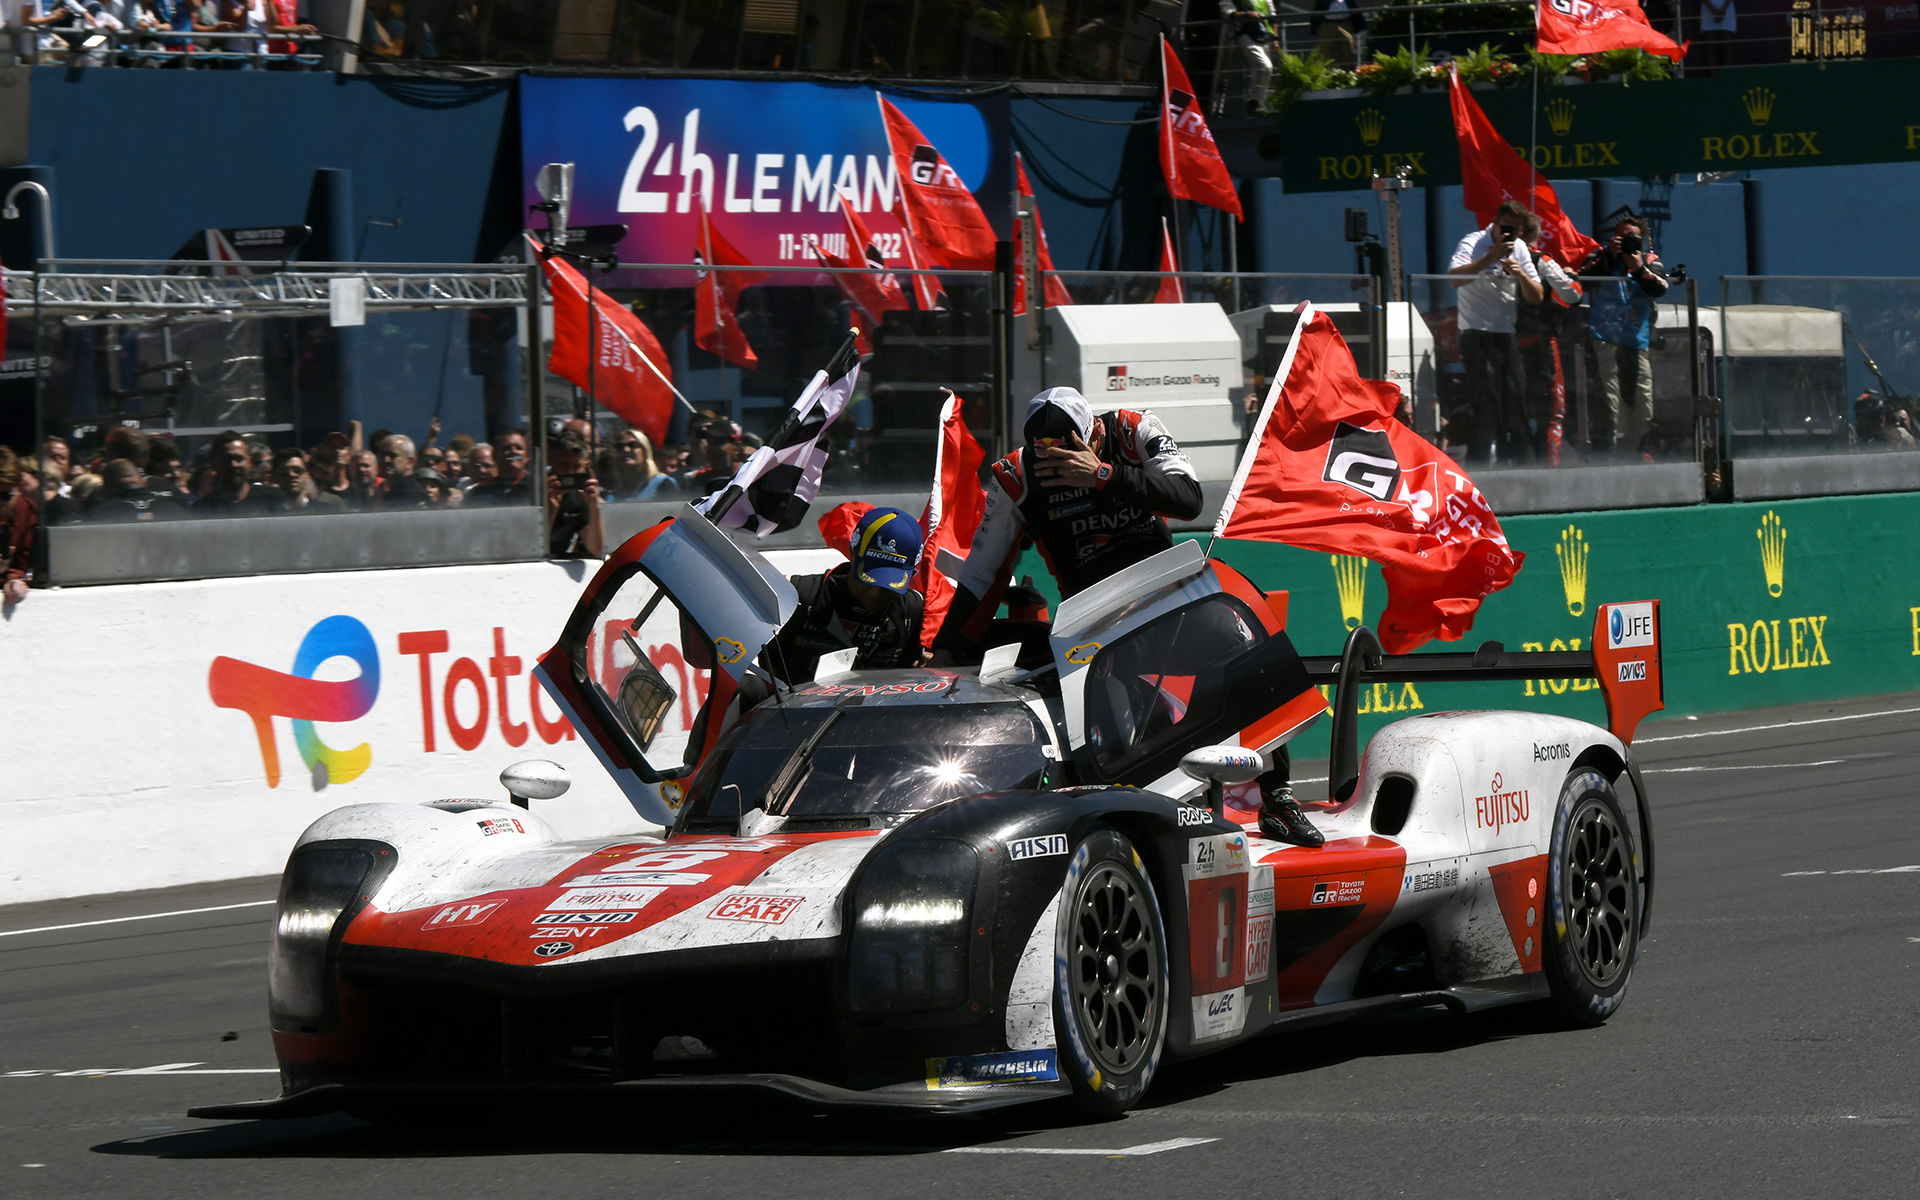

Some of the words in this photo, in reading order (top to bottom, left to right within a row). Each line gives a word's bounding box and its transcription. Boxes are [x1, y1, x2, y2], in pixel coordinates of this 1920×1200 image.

[1701, 131, 1822, 161] ROLEX
[616, 106, 715, 213] 24h
[724, 153, 785, 213] LE
[791, 153, 899, 213] MAN
[1319, 152, 1428, 180] ROLEX
[1129, 376, 1161, 387] TOYOTA
[1163, 375, 1192, 386] GAZOO
[1193, 374, 1220, 388] Racing
[1390, 369, 1413, 382] Racin
[865, 550, 907, 564] MICHELIN
[1625, 616, 1651, 637] JFE
[1726, 615, 1832, 676] ROLEX
[796, 681, 950, 697] DENSO
[1225, 756, 1250, 768] Mobil
[1533, 742, 1571, 763] Acronis
[1177, 807, 1213, 827] RAYS
[1475, 789, 1530, 838] FUJITSU
[1012, 836, 1067, 858] AISIN
[1196, 840, 1215, 864] 24h
[601, 851, 730, 873] 8
[1339, 887, 1363, 896] GAZOO
[1341, 880, 1365, 889] TOYOTA
[726, 896, 796, 907] HYPER
[1312, 891, 1337, 904] GR
[1337, 894, 1361, 903] Racing
[429, 903, 498, 925] HY
[533, 912, 634, 923] AISIN
[716, 903, 788, 921] CAR
[529, 926, 609, 939] ZENT
[1215, 886, 1237, 979] 8
[1247, 921, 1270, 943] HYPER
[1246, 940, 1269, 977] CAR
[972, 1059, 1049, 1078] MICHELIN
